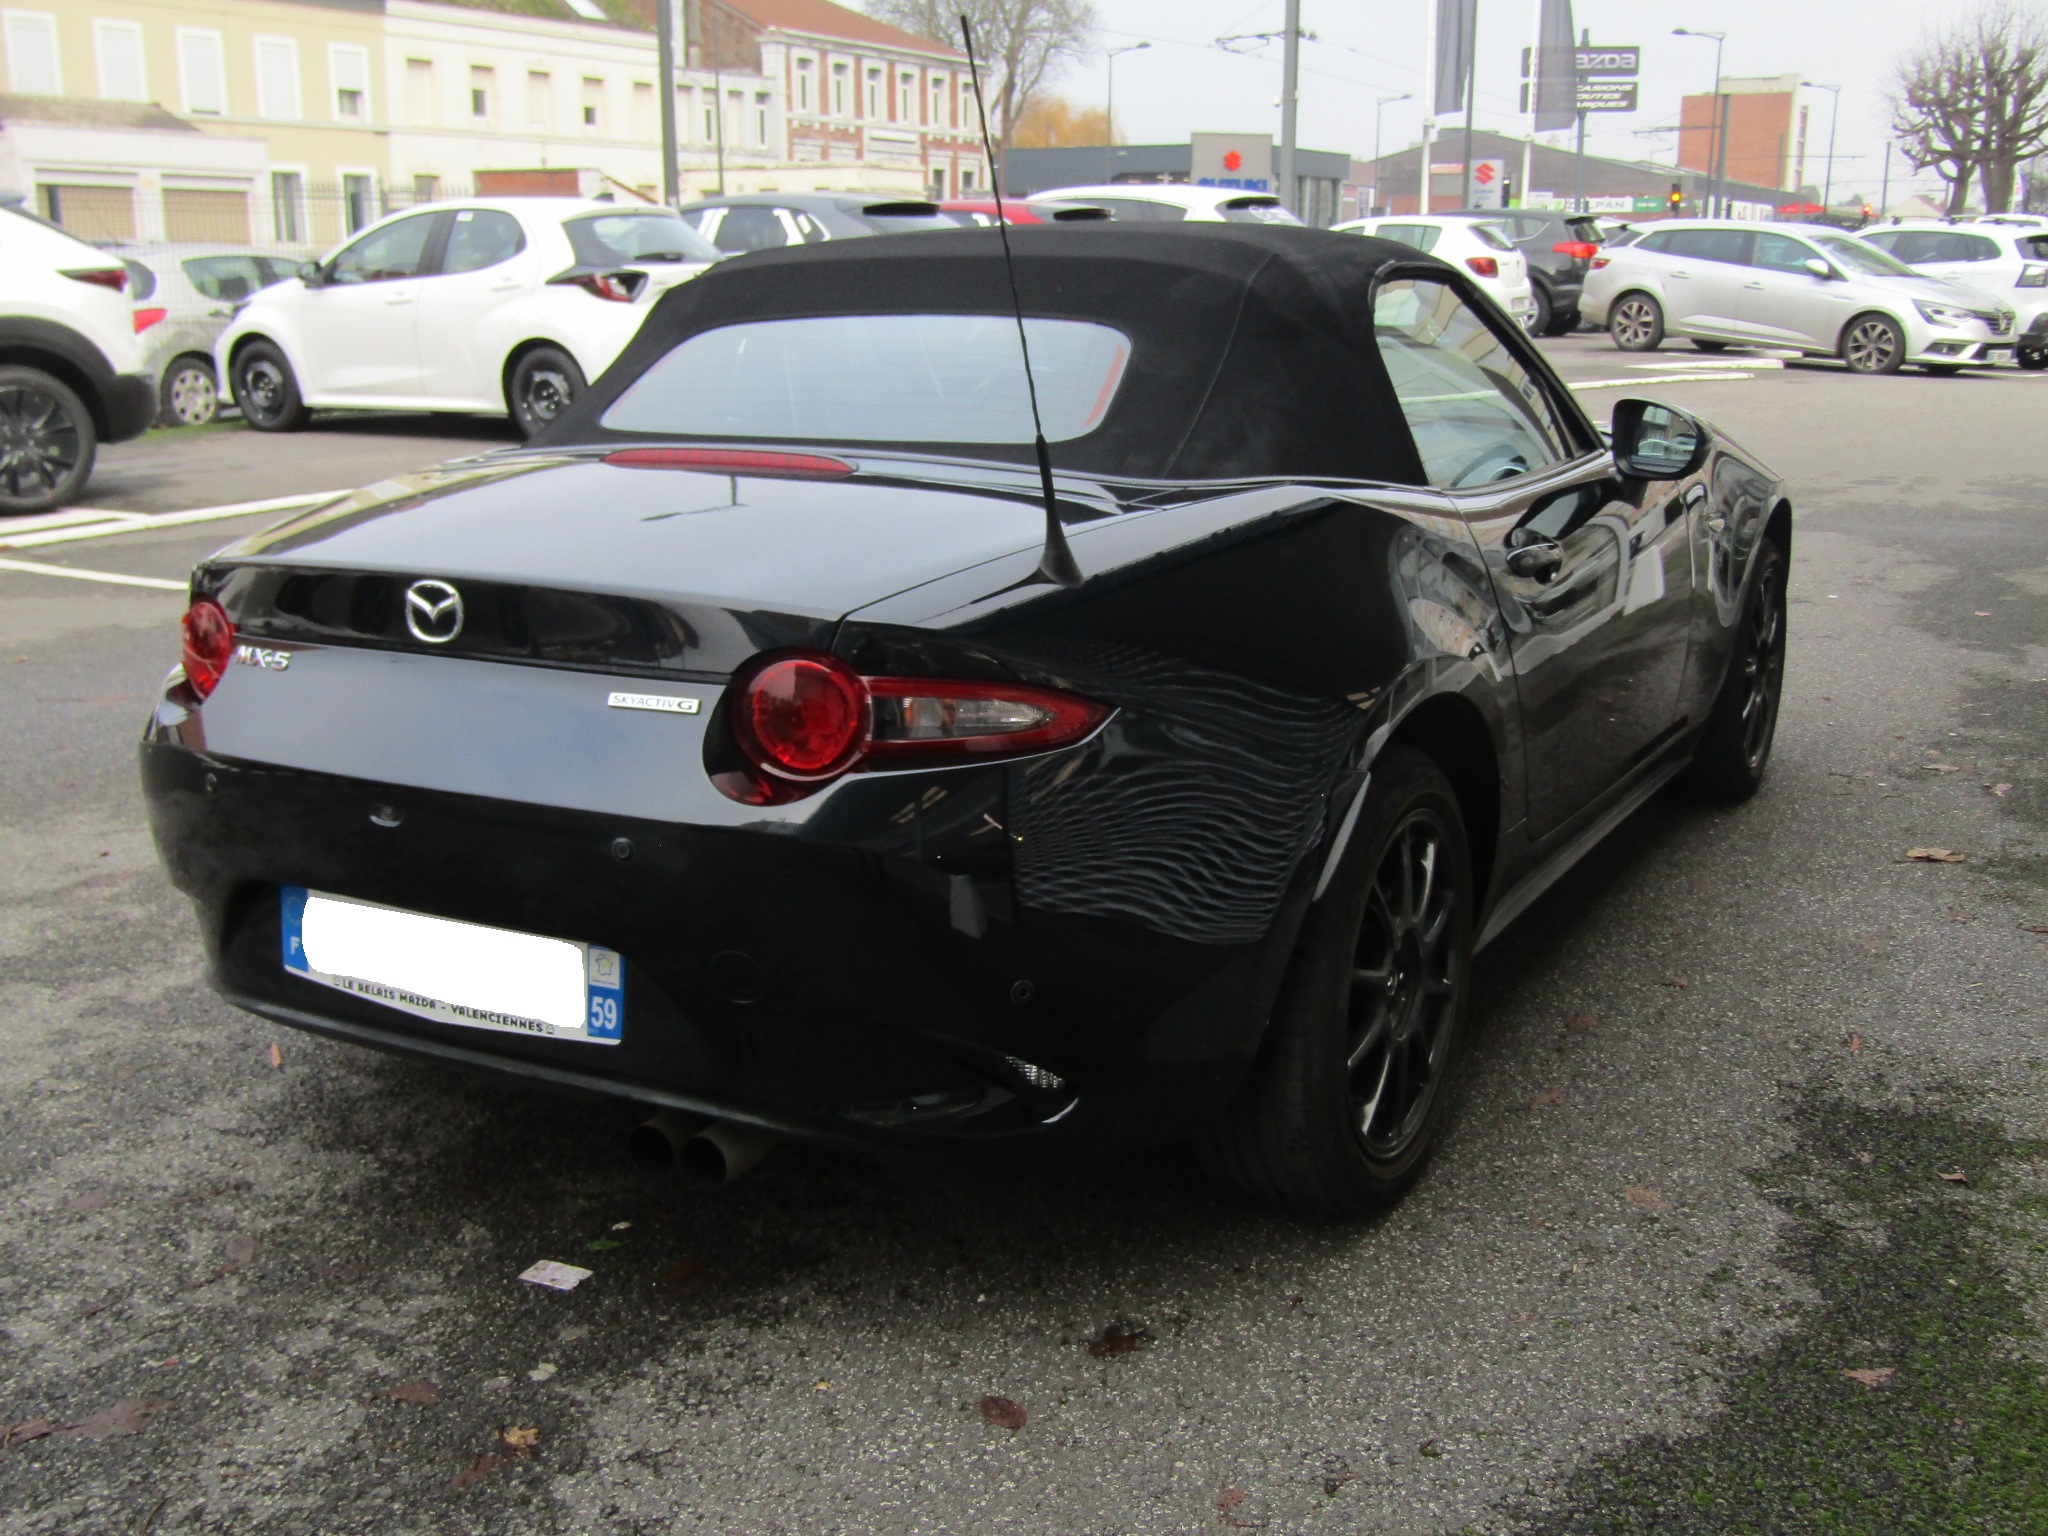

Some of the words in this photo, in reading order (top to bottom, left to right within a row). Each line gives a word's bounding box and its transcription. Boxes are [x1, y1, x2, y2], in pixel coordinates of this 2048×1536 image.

[234, 644, 291, 671] MX-5
[290, 936, 300, 955] F
[342, 978, 354, 990] LE
[358, 983, 395, 1000] RELAIS
[450, 1003, 544, 1033] VALENCIENNES
[591, 996, 617, 1030] 59
